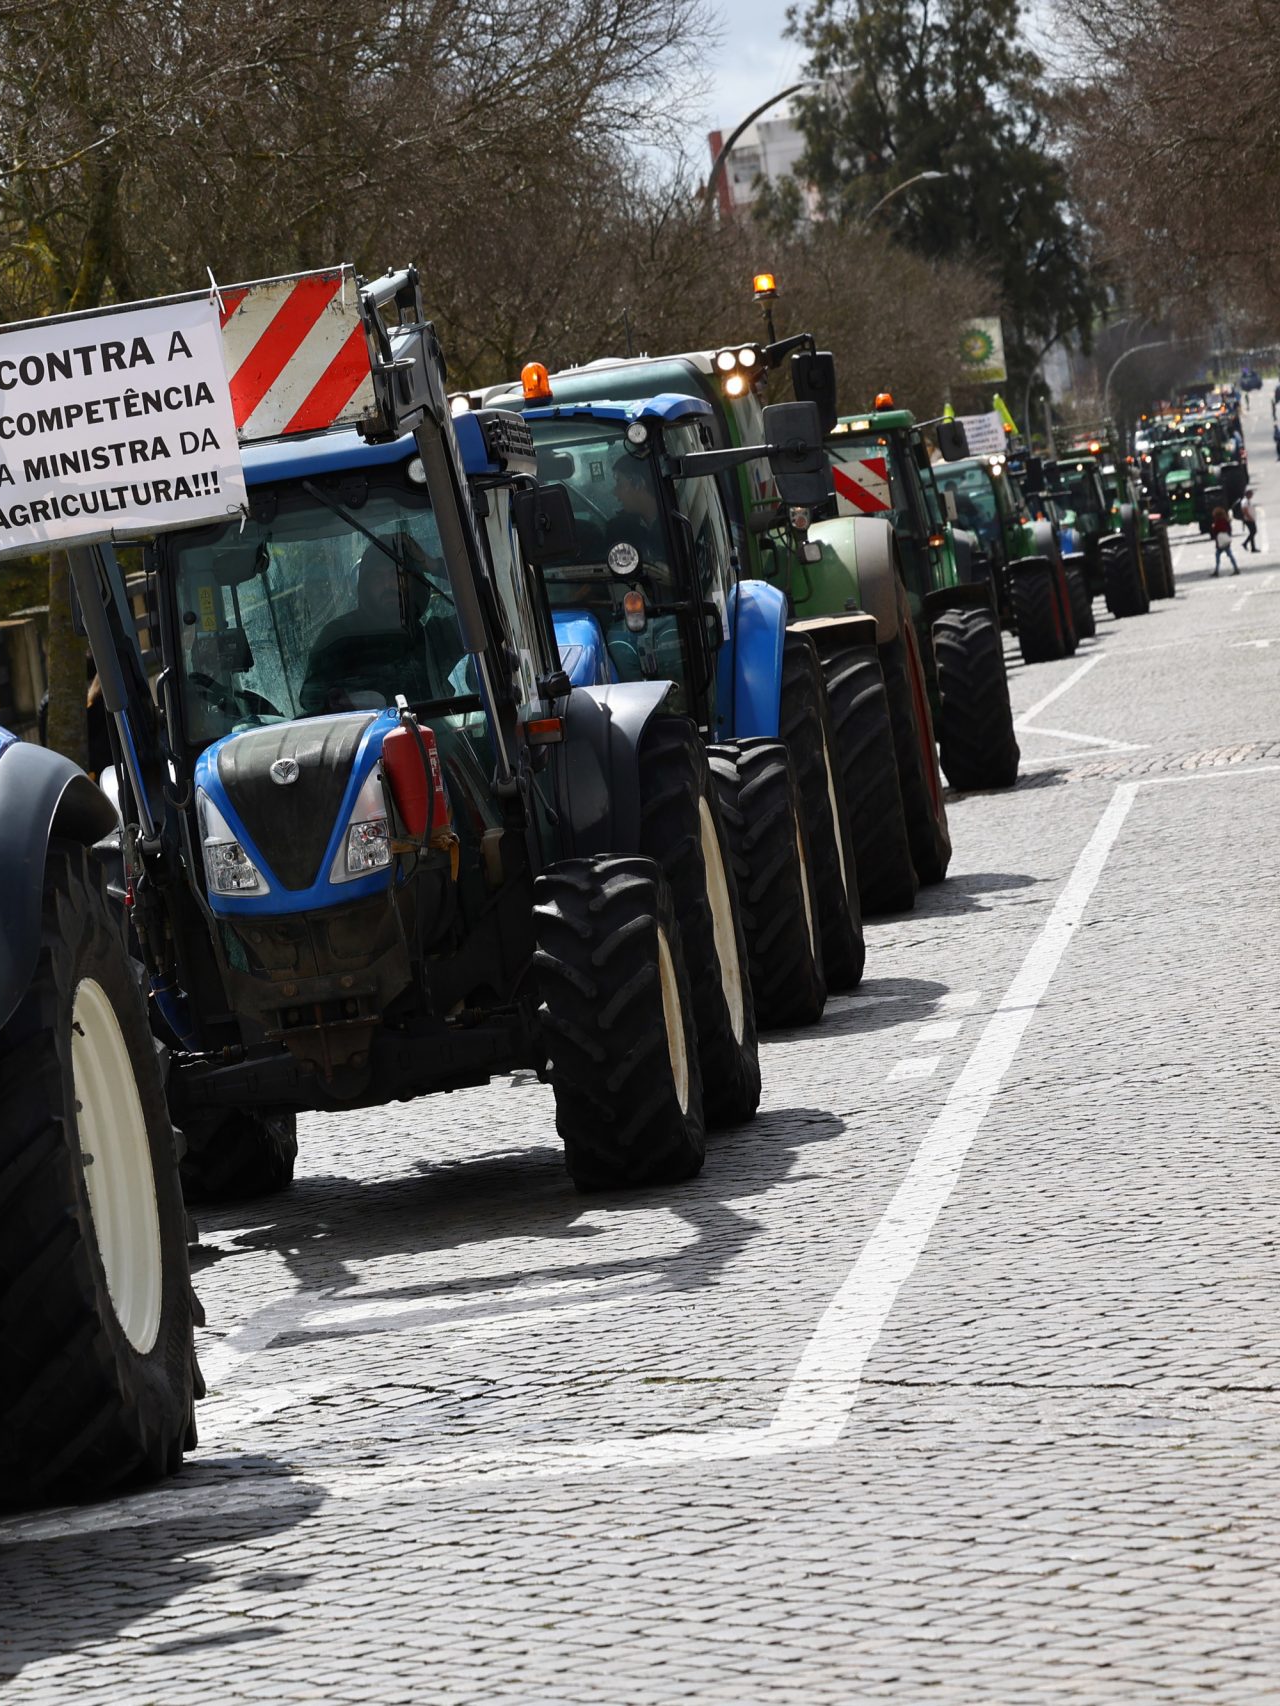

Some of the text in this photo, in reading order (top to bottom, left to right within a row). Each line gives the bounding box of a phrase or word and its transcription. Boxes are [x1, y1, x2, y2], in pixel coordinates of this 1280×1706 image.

[167, 330, 193, 362] A
[22, 436, 172, 483] MINISTRA
[179, 427, 221, 456] DA
